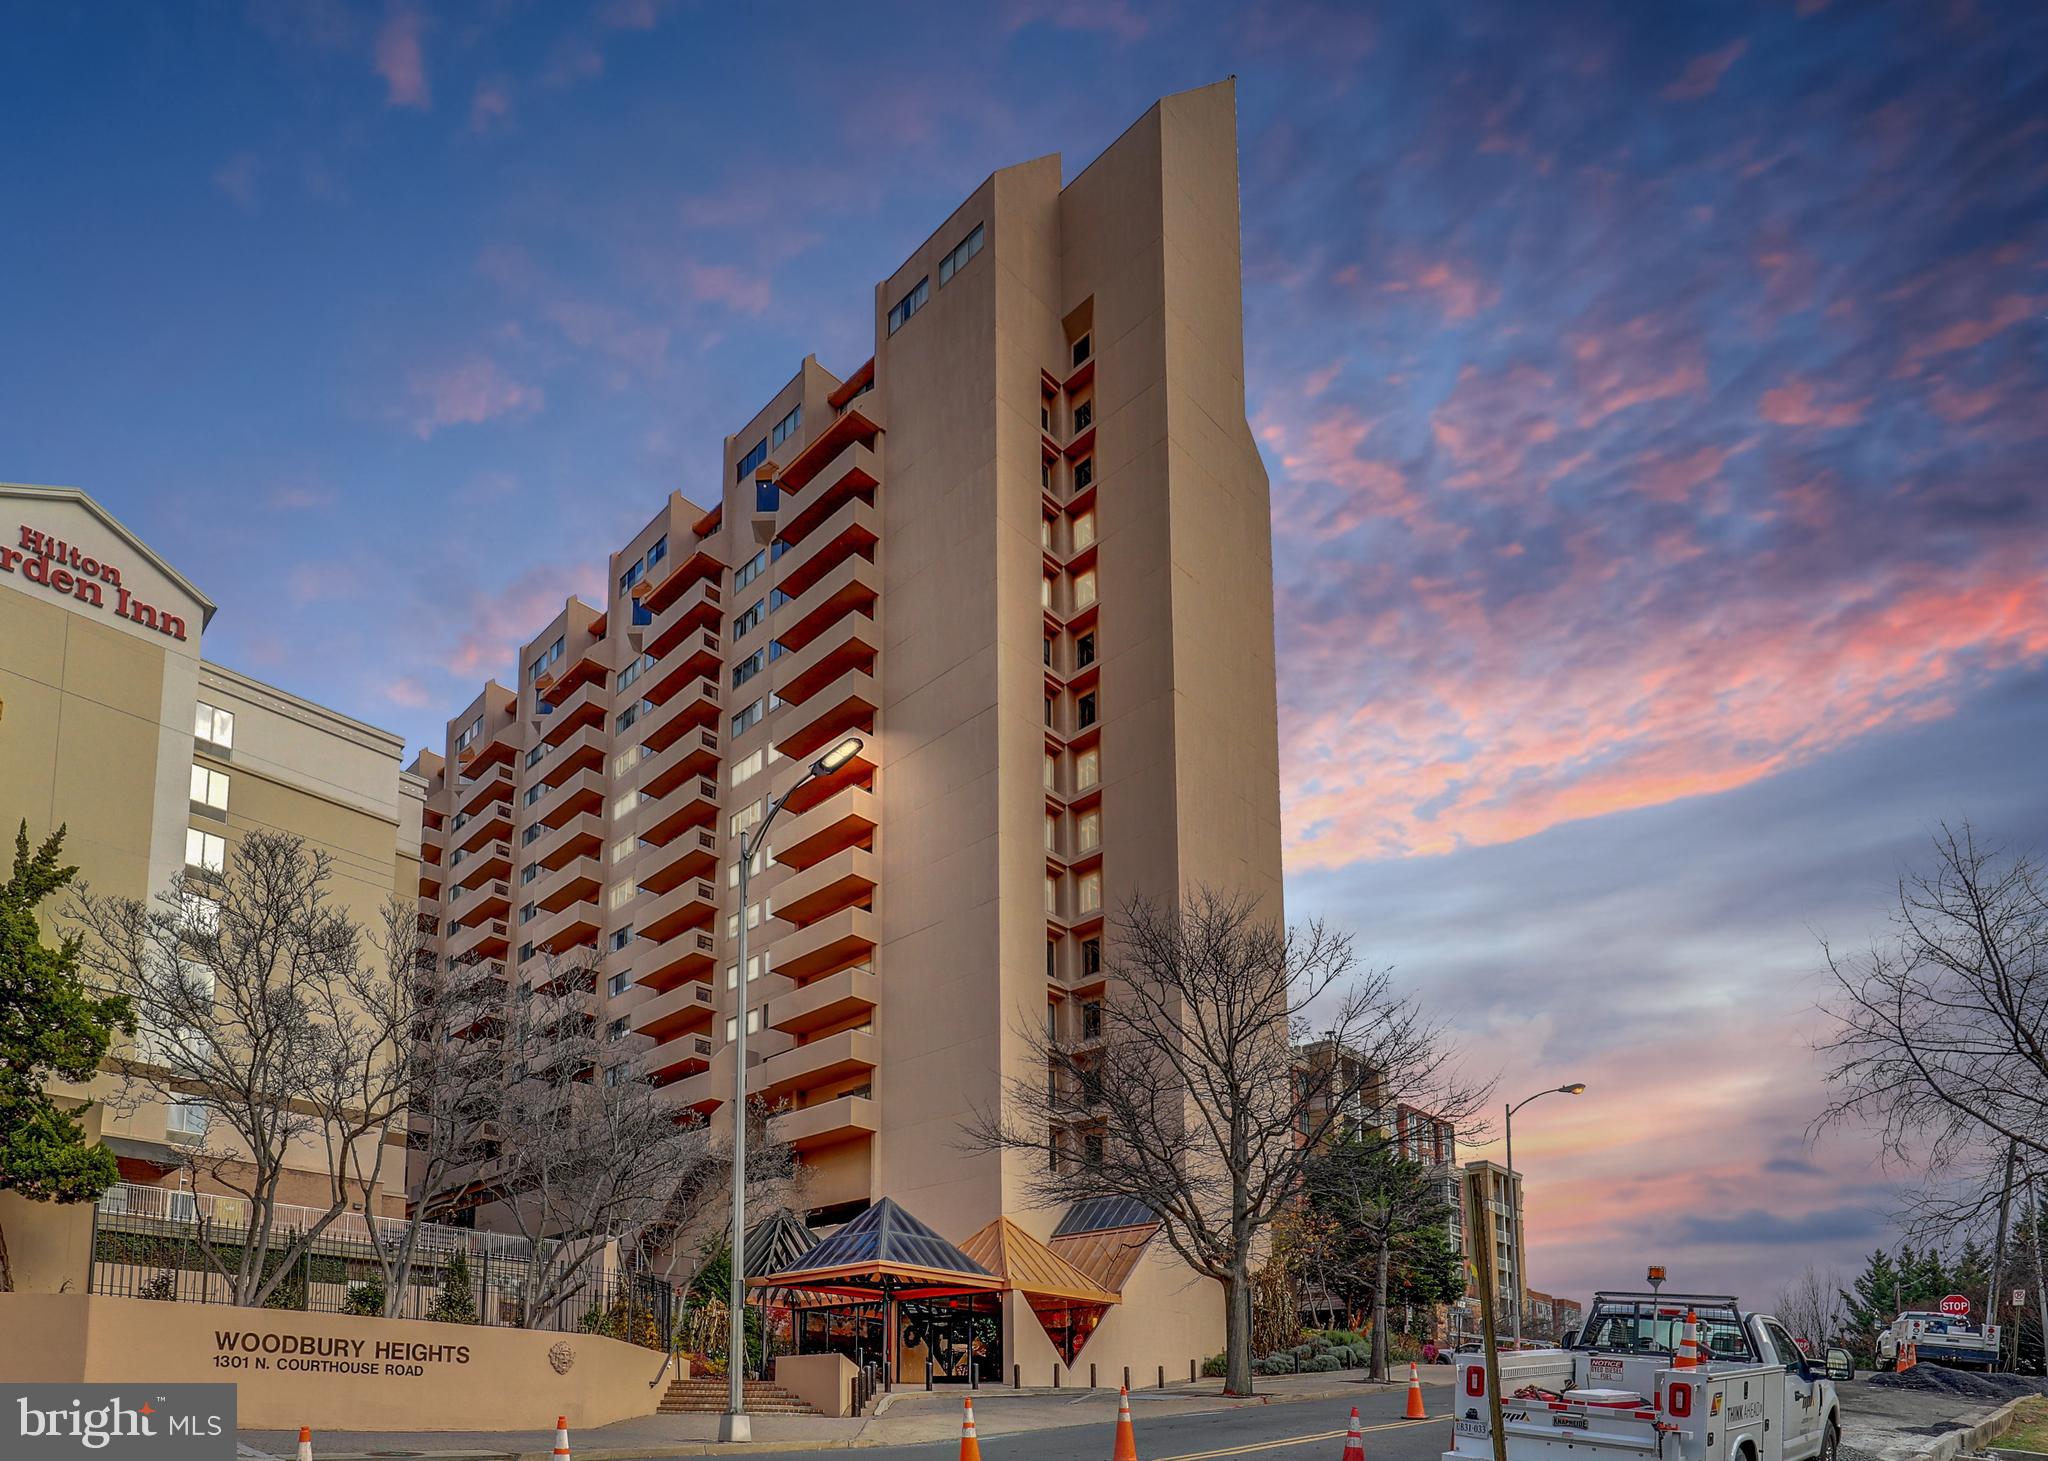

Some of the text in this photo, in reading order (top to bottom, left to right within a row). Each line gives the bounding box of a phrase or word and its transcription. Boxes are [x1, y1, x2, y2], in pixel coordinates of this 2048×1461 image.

[18, 524, 122, 587] Hilton
[115, 586, 187, 642] Inn
[1942, 1301, 1968, 1311] STOP
[214, 1331, 470, 1364] WOODBURY HEIGHTS
[213, 1355, 424, 1376] 1301 N. COURTHOUSE ROAD
[1727, 1405, 1744, 1423] THINK
